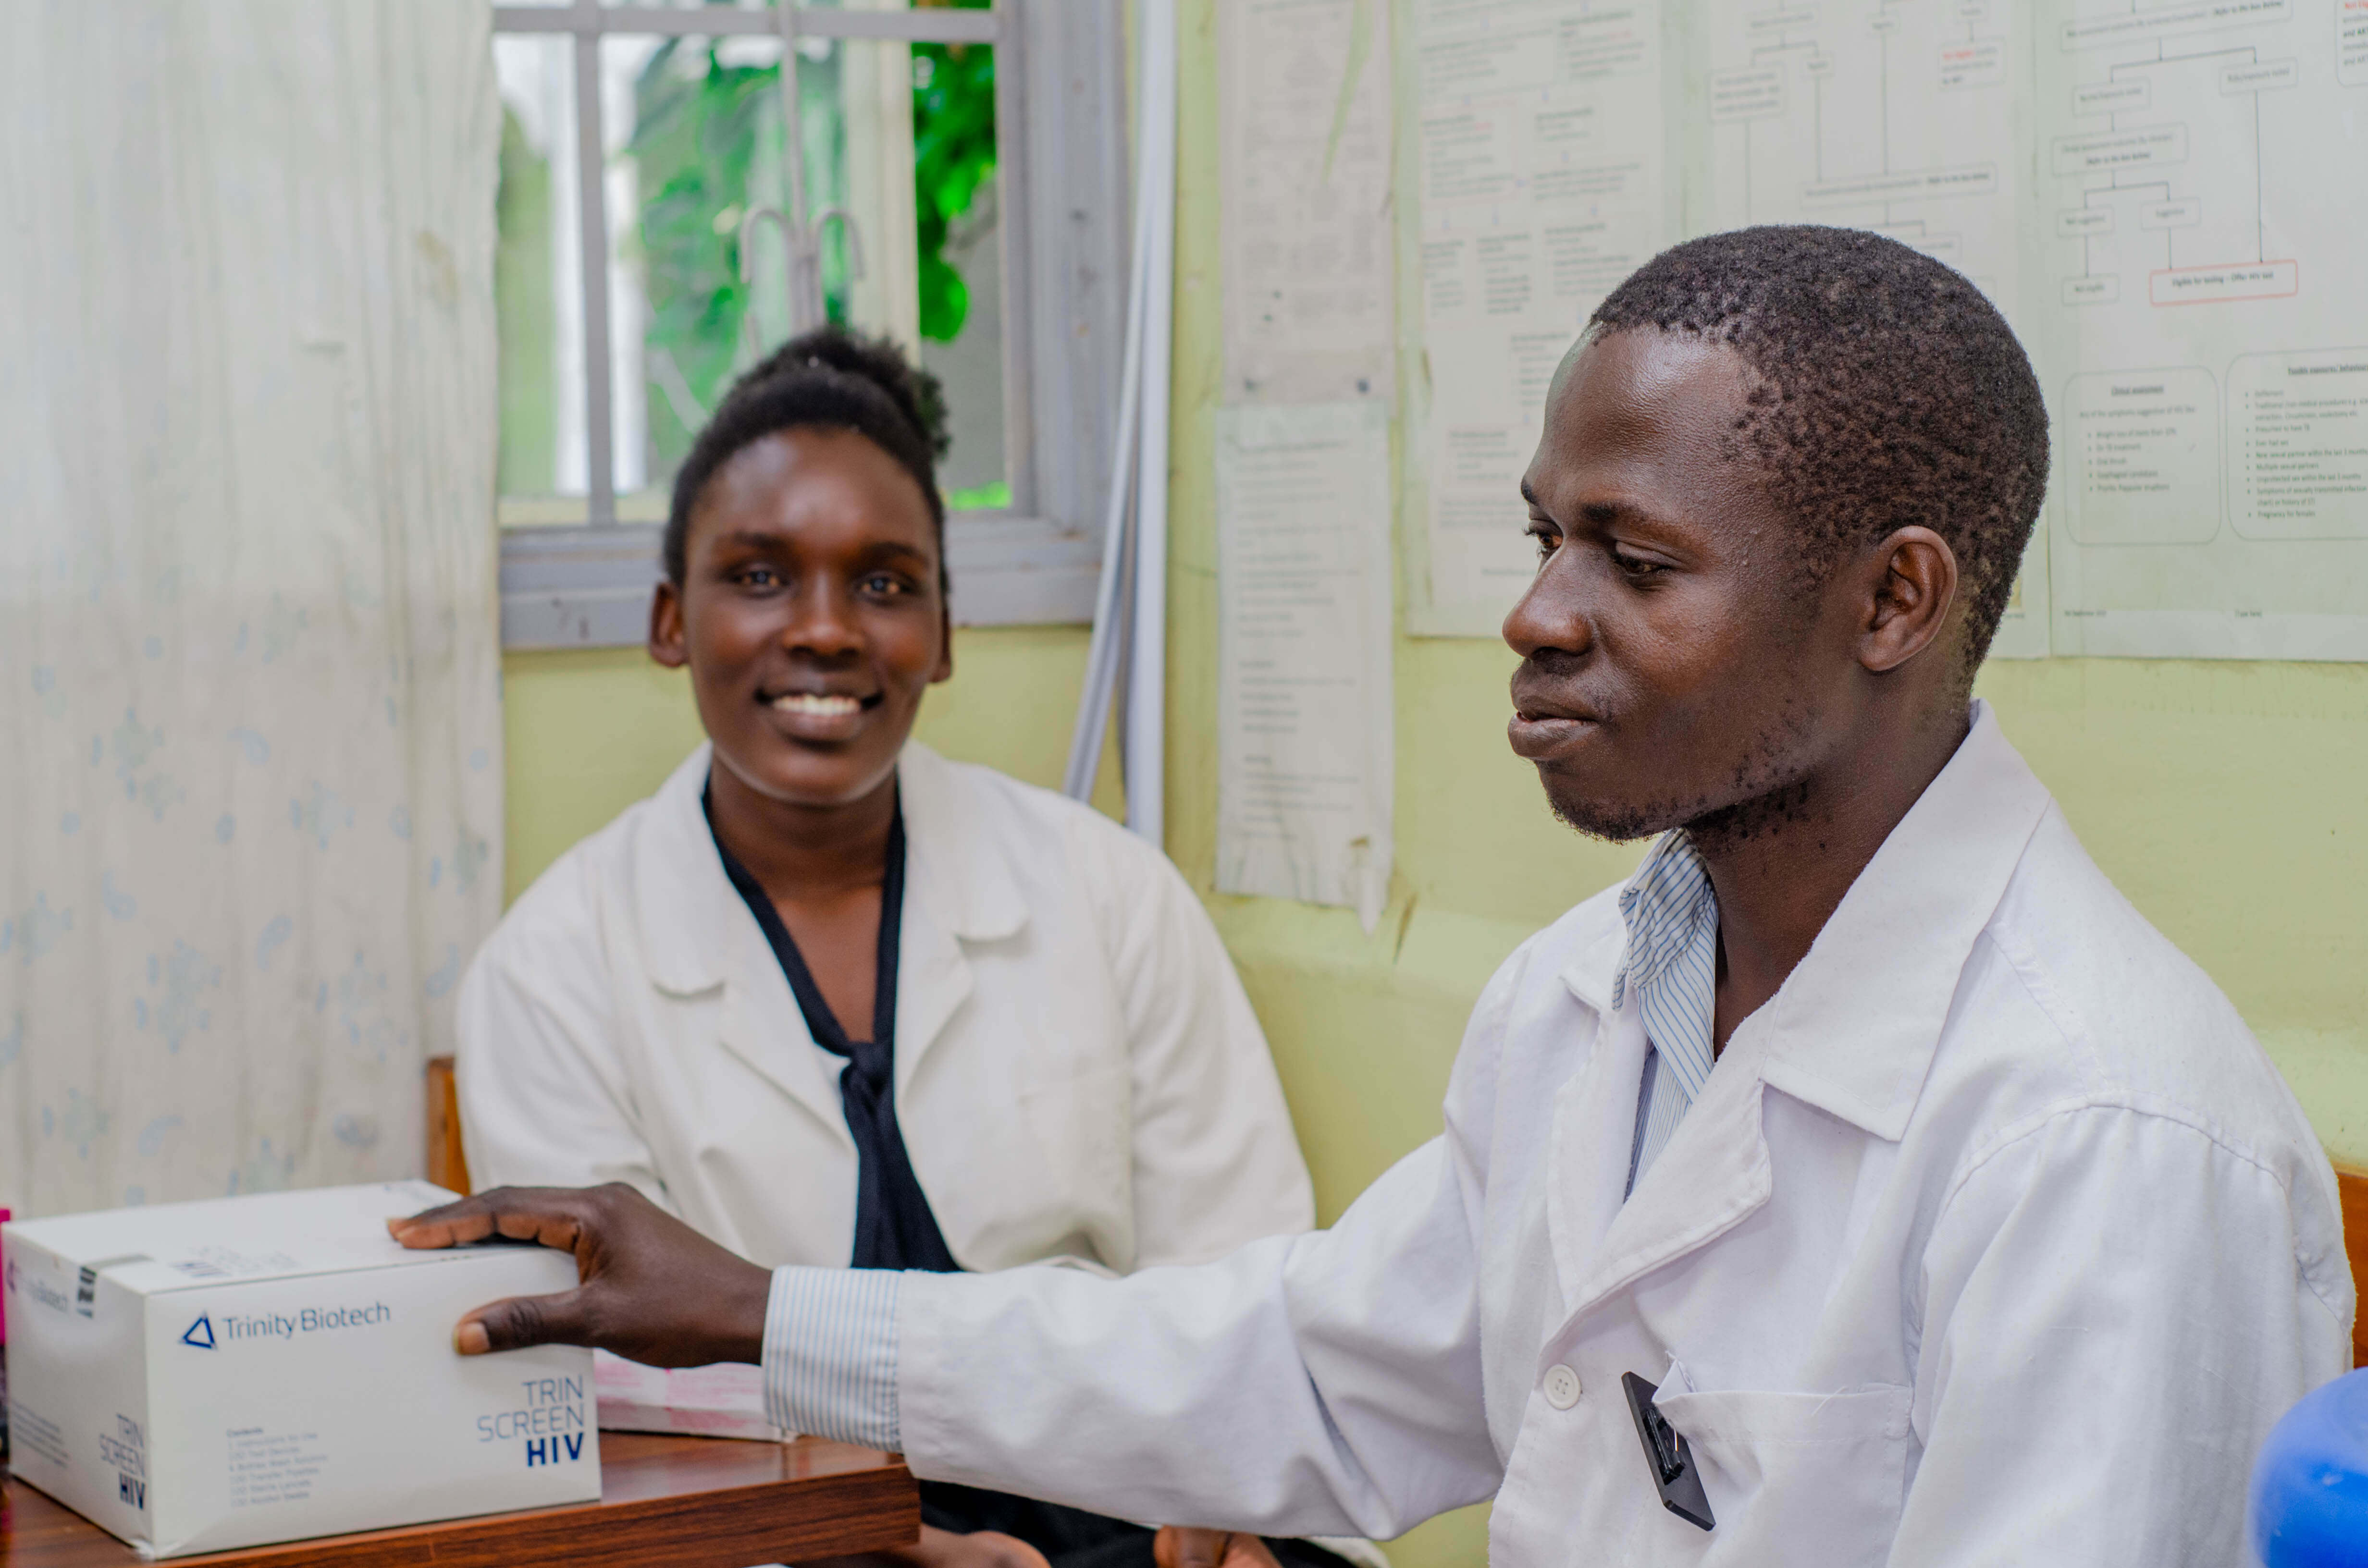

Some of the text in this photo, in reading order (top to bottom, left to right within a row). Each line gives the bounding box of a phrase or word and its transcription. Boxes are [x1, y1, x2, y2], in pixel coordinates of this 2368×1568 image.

[221, 1301, 391, 1340] Trinity Biotech
[521, 1374, 583, 1407] TRIN
[116, 1412, 145, 1449] TRIN
[477, 1402, 584, 1443] SCREEN
[99, 1433, 145, 1479] SCREEN
[527, 1431, 584, 1467] HIV
[119, 1471, 146, 1510] HIV
